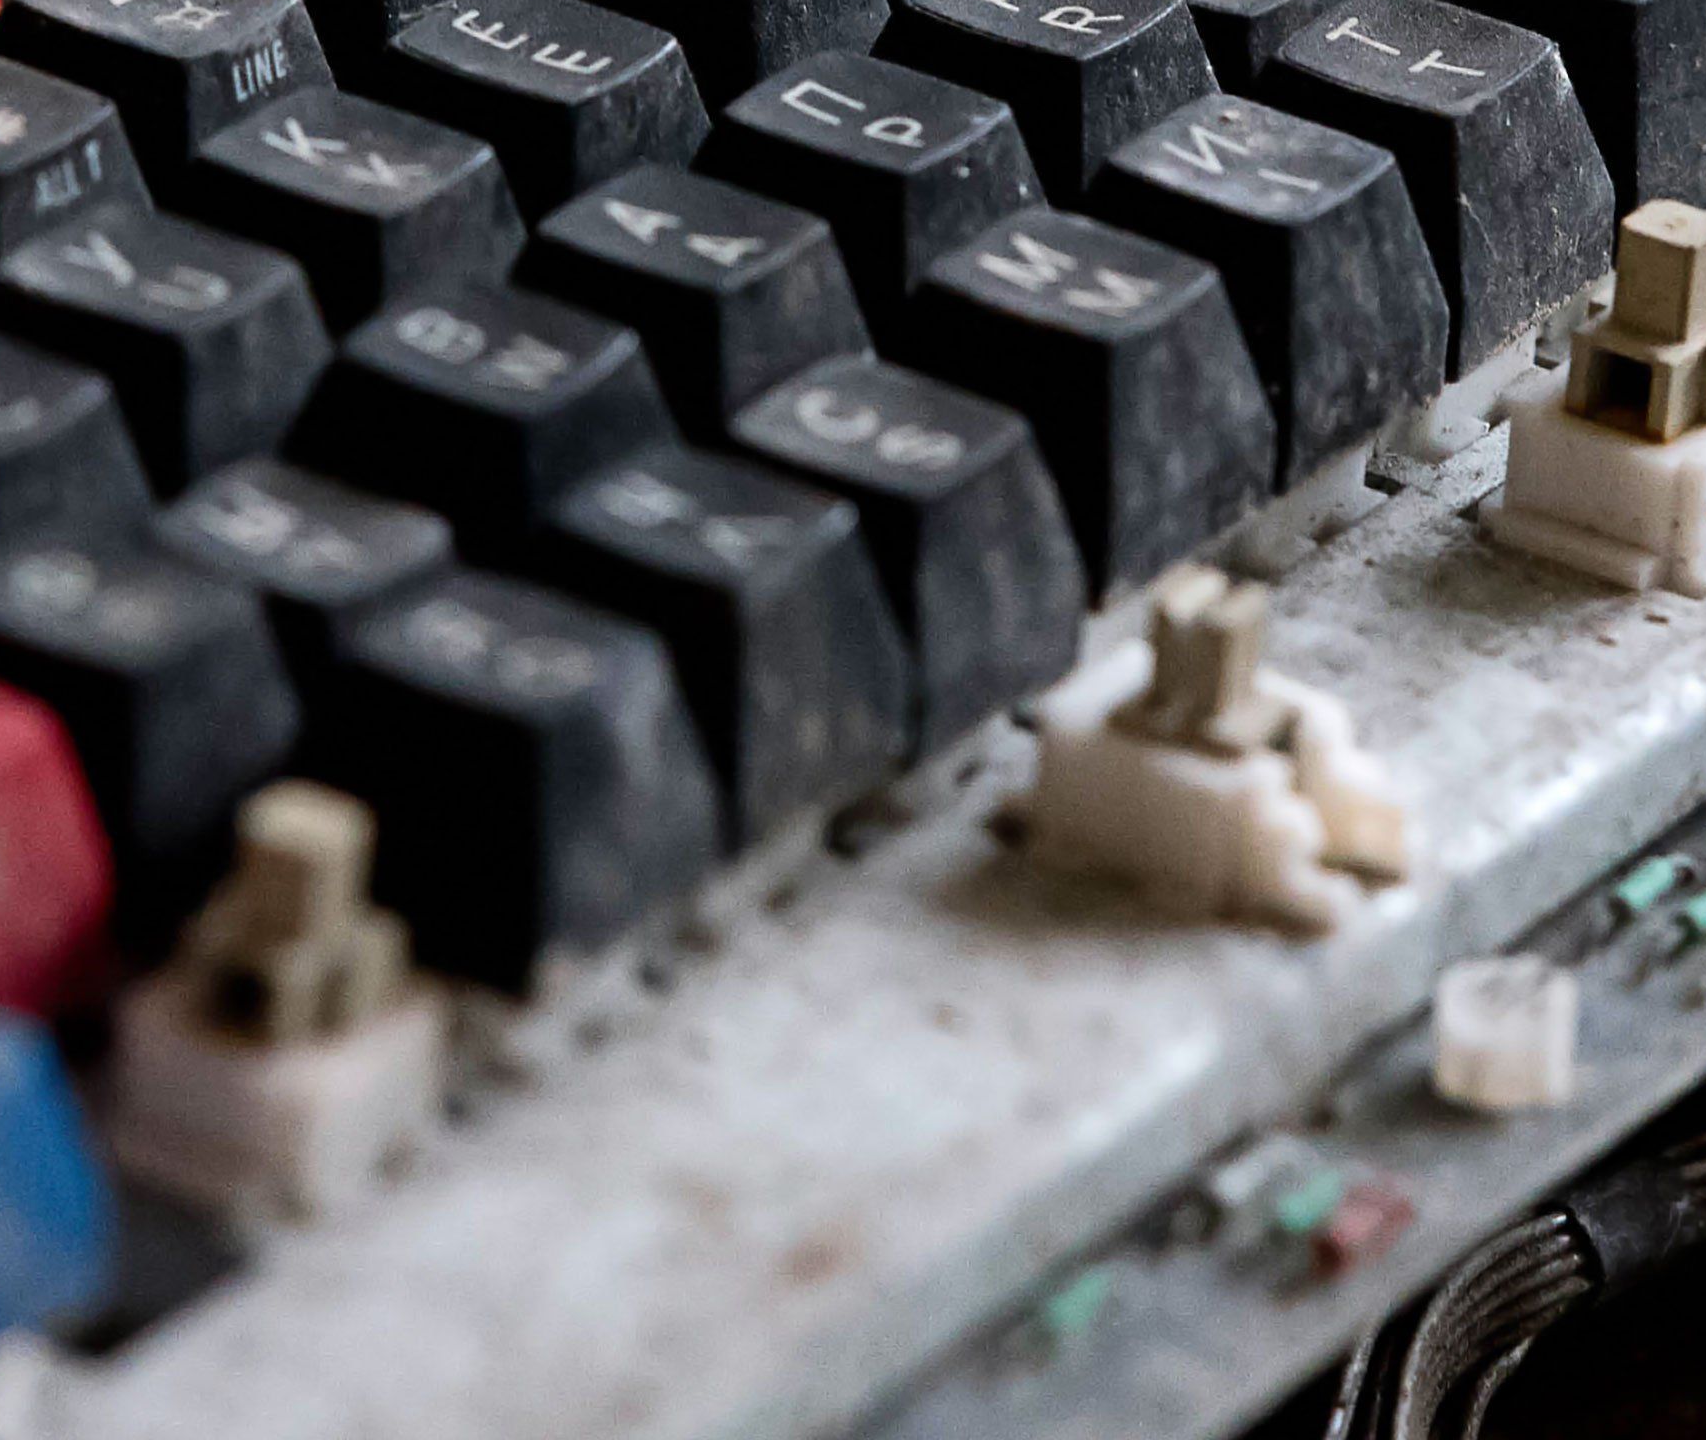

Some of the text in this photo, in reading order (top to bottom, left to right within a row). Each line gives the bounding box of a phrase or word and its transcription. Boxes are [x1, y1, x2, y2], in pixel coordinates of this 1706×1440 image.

[451, 9, 531, 51] Е
[1038, 4, 1125, 35] R
[1324, 16, 1402, 57] Т
[231, 38, 289, 101] LINE
[531, 43, 612, 75] E
[1407, 49, 1486, 78] T
[779, 77, 867, 128] П
[260, 115, 349, 164] К
[861, 115, 926, 150] P
[601, 196, 684, 245] А
[686, 231, 769, 268] A
[975, 231, 1079, 293] М
[1060, 266, 1163, 319] M
[795, 387, 882, 445] С
